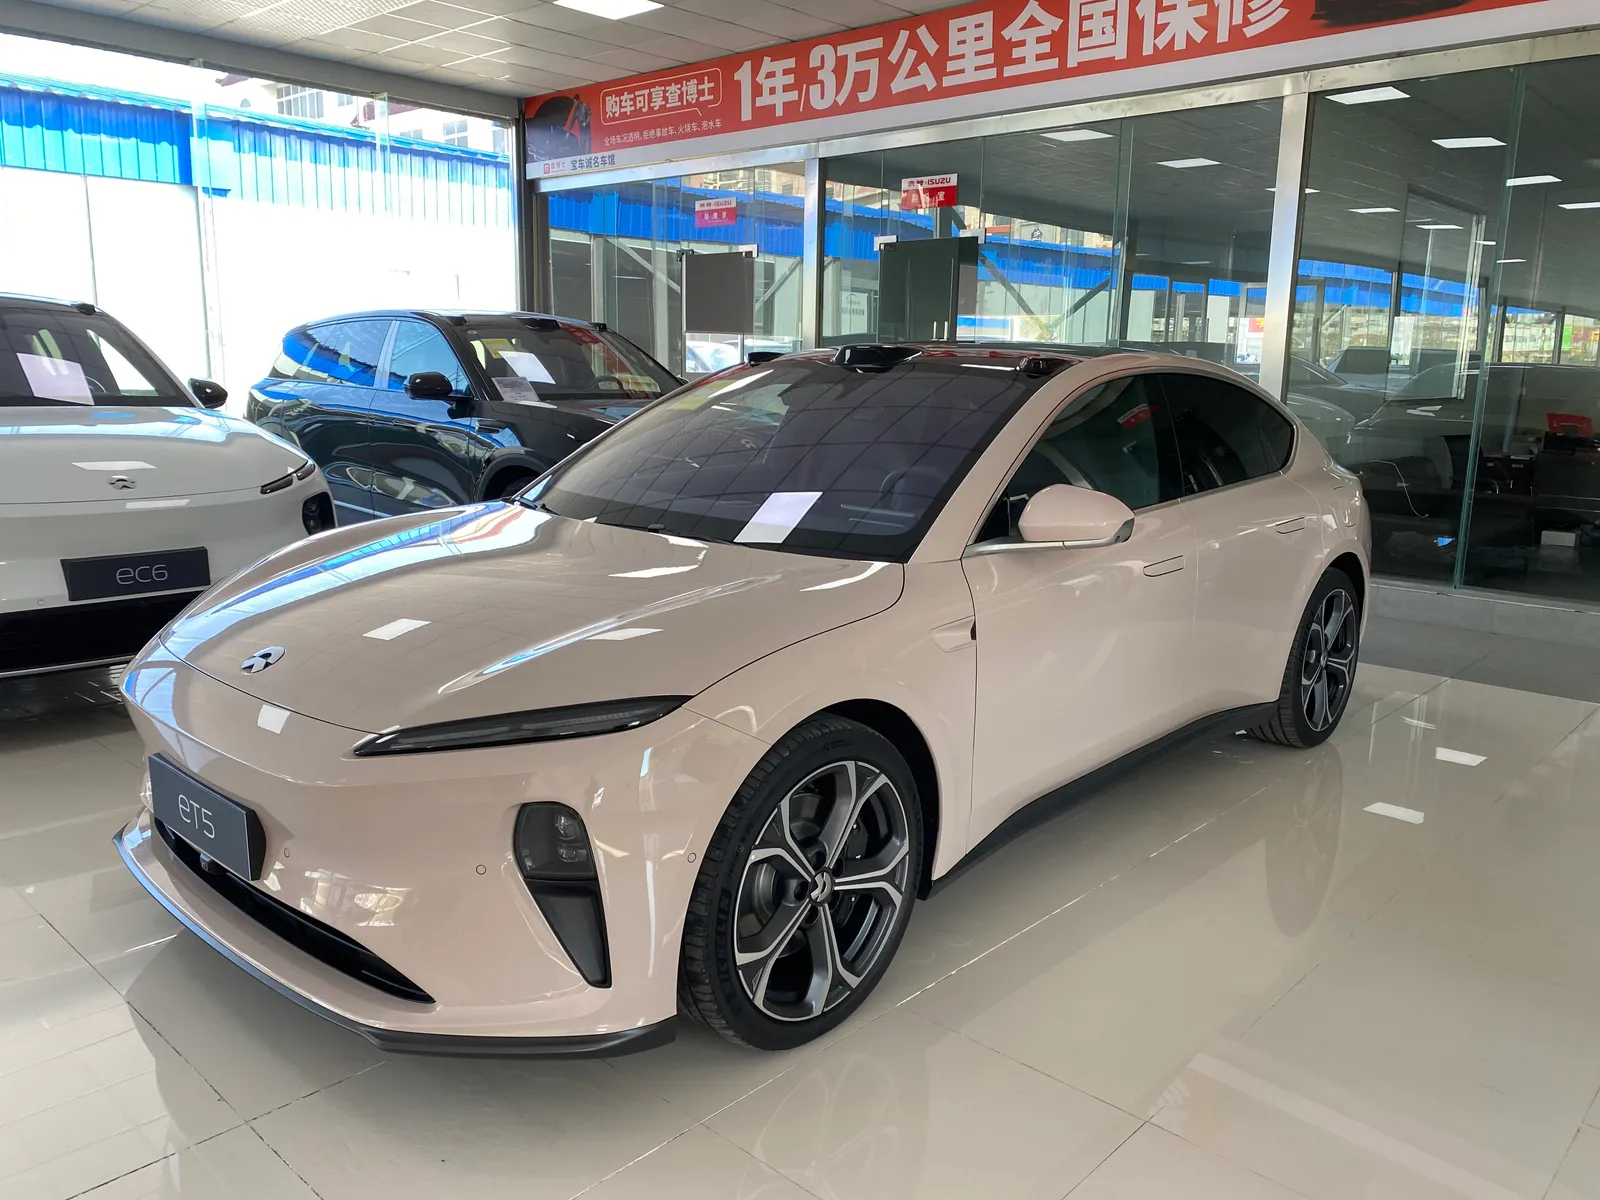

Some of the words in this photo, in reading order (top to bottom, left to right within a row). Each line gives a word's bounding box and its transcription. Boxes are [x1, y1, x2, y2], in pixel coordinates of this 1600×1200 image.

[734, 0, 1289, 121] 1年/3万公里全国保修
[605, 76, 715, 118] 购车可享查博士
[570, 153, 616, 171] 宝车诚名车馆
[927, 177, 951, 186] ISUZU
